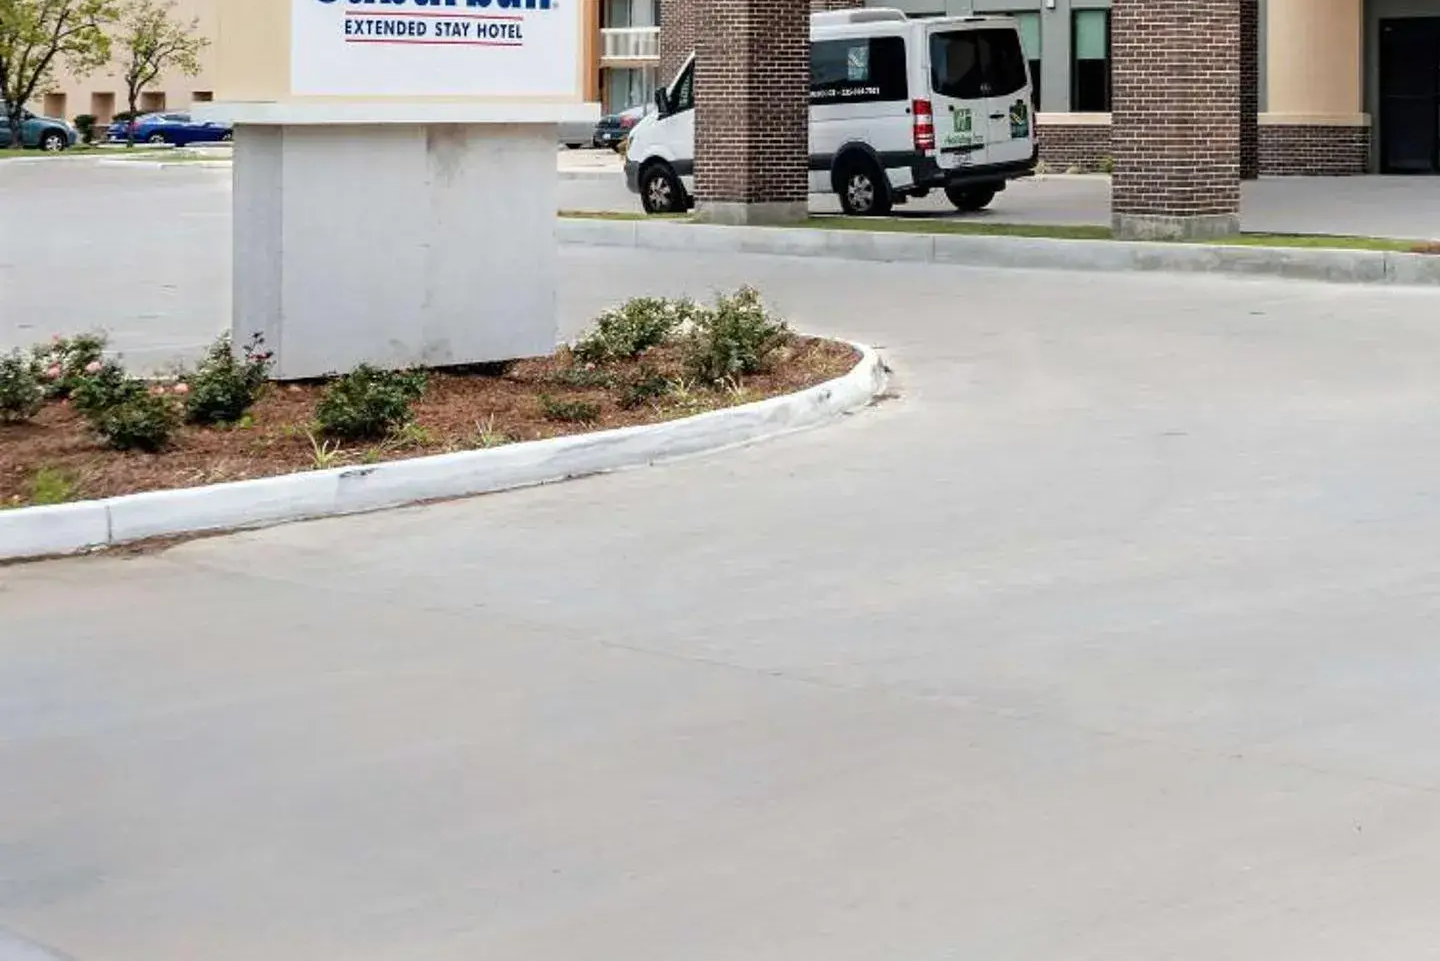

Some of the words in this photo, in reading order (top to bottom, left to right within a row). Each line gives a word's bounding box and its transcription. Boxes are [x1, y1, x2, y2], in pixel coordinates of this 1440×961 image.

[344, 19, 427, 36] EXTENDED
[434, 21, 470, 38] STAY
[477, 23, 523, 39] HOTEL
